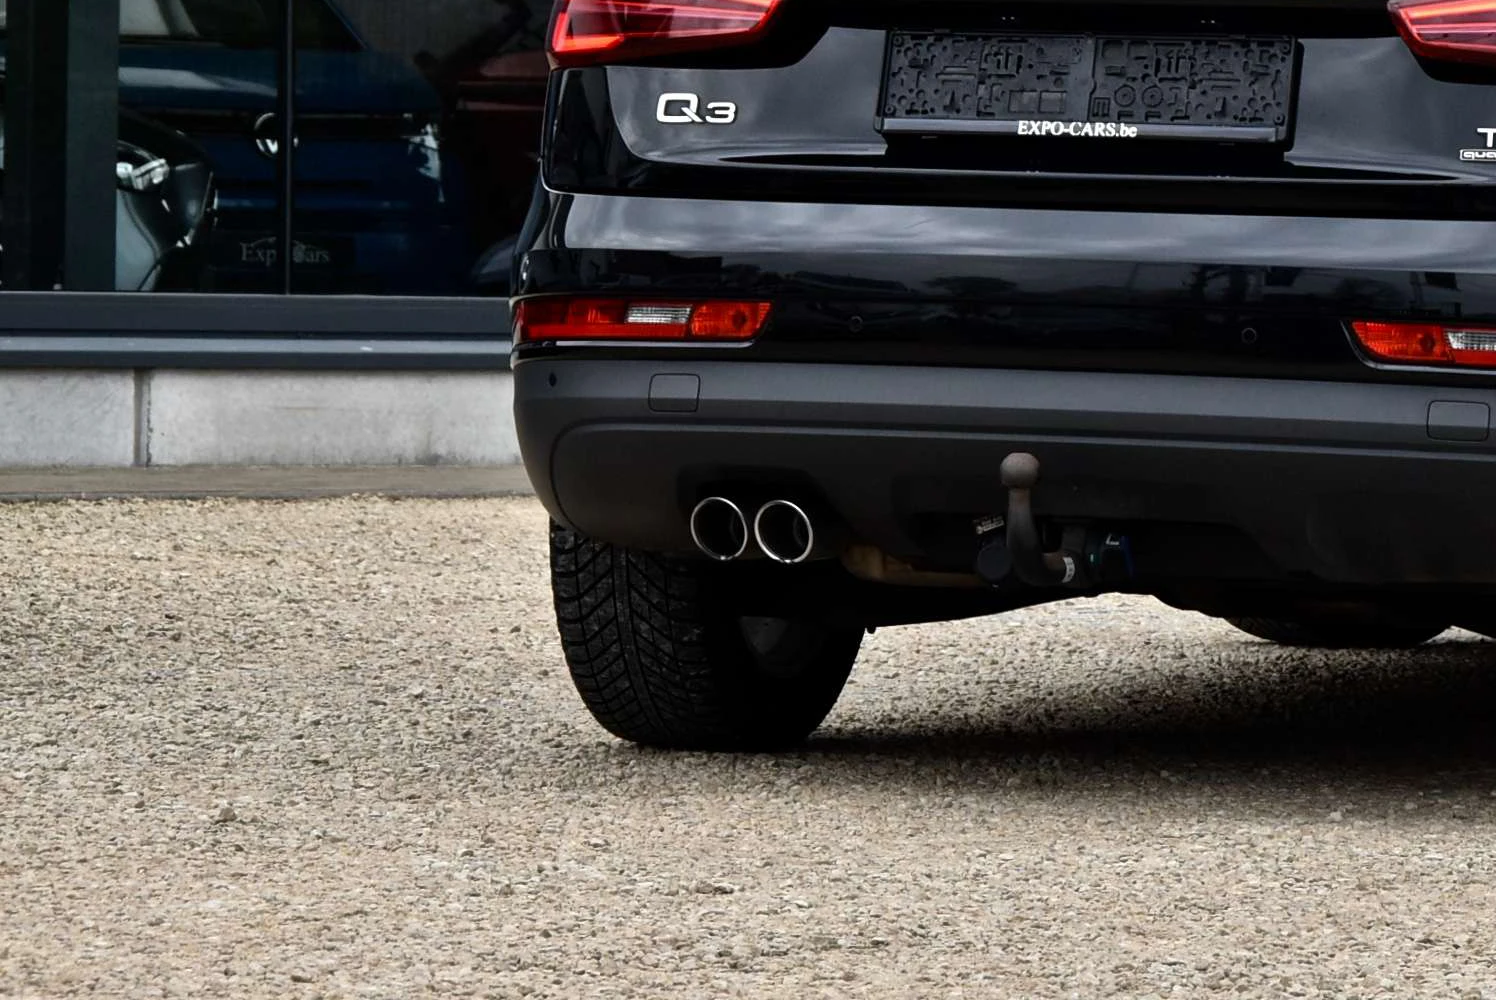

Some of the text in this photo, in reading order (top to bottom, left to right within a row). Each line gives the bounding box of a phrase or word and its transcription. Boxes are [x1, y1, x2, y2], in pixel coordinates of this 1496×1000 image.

[656, 92, 737, 124] Q3
[1017, 120, 1138, 138] EXPO-CARS.be
[240, 242, 278, 267] Exp
